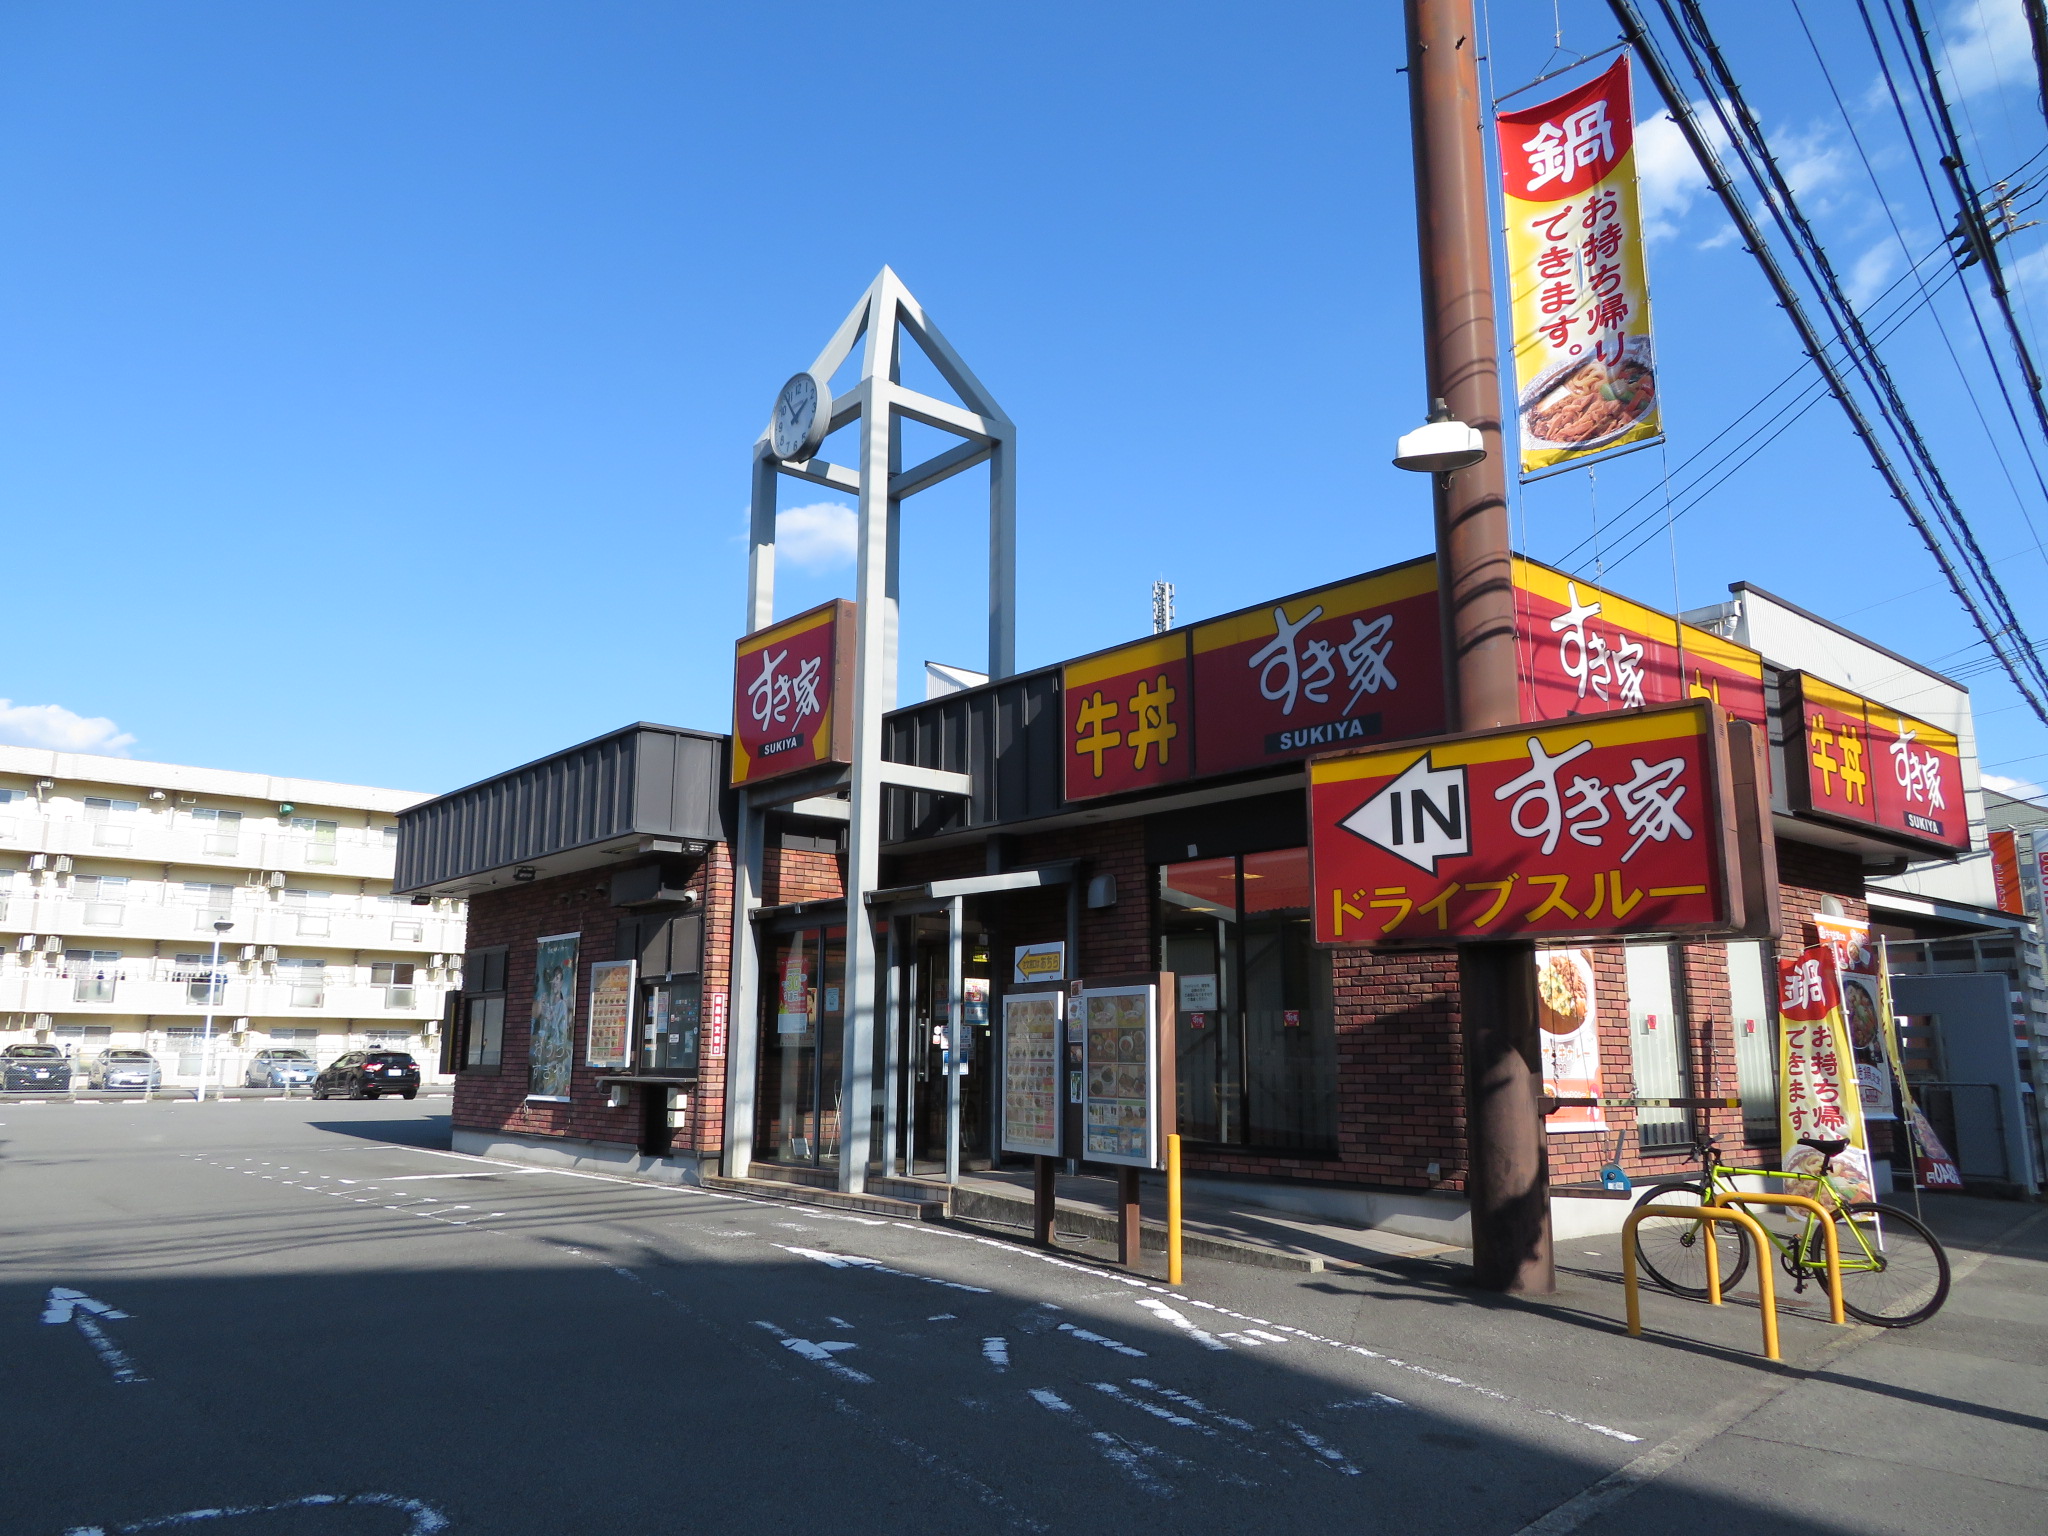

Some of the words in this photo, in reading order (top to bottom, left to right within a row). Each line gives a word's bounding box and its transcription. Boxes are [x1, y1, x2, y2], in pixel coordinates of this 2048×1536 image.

[1522, 99, 1616, 192] 鍋
[1531, 204, 1584, 356] できます。
[1581, 189, 1629, 368] お持ち帰り
[748, 648, 823, 733] すき家
[1248, 604, 1398, 717] すき家
[764, 737, 798, 757] SUKIYA
[1075, 673, 1178, 779] 牛丼
[1279, 718, 1365, 751] SUKIYA
[1810, 711, 1866, 807] 牛丼
[1888, 714, 1946, 817] すき家
[1390, 784, 1463, 846] IN
[1494, 736, 1694, 864] すき家
[1906, 811, 1940, 836] SUKIYA
[1332, 869, 1707, 937] ドライブスルー
[1782, 958, 1826, 1011] 鍋
